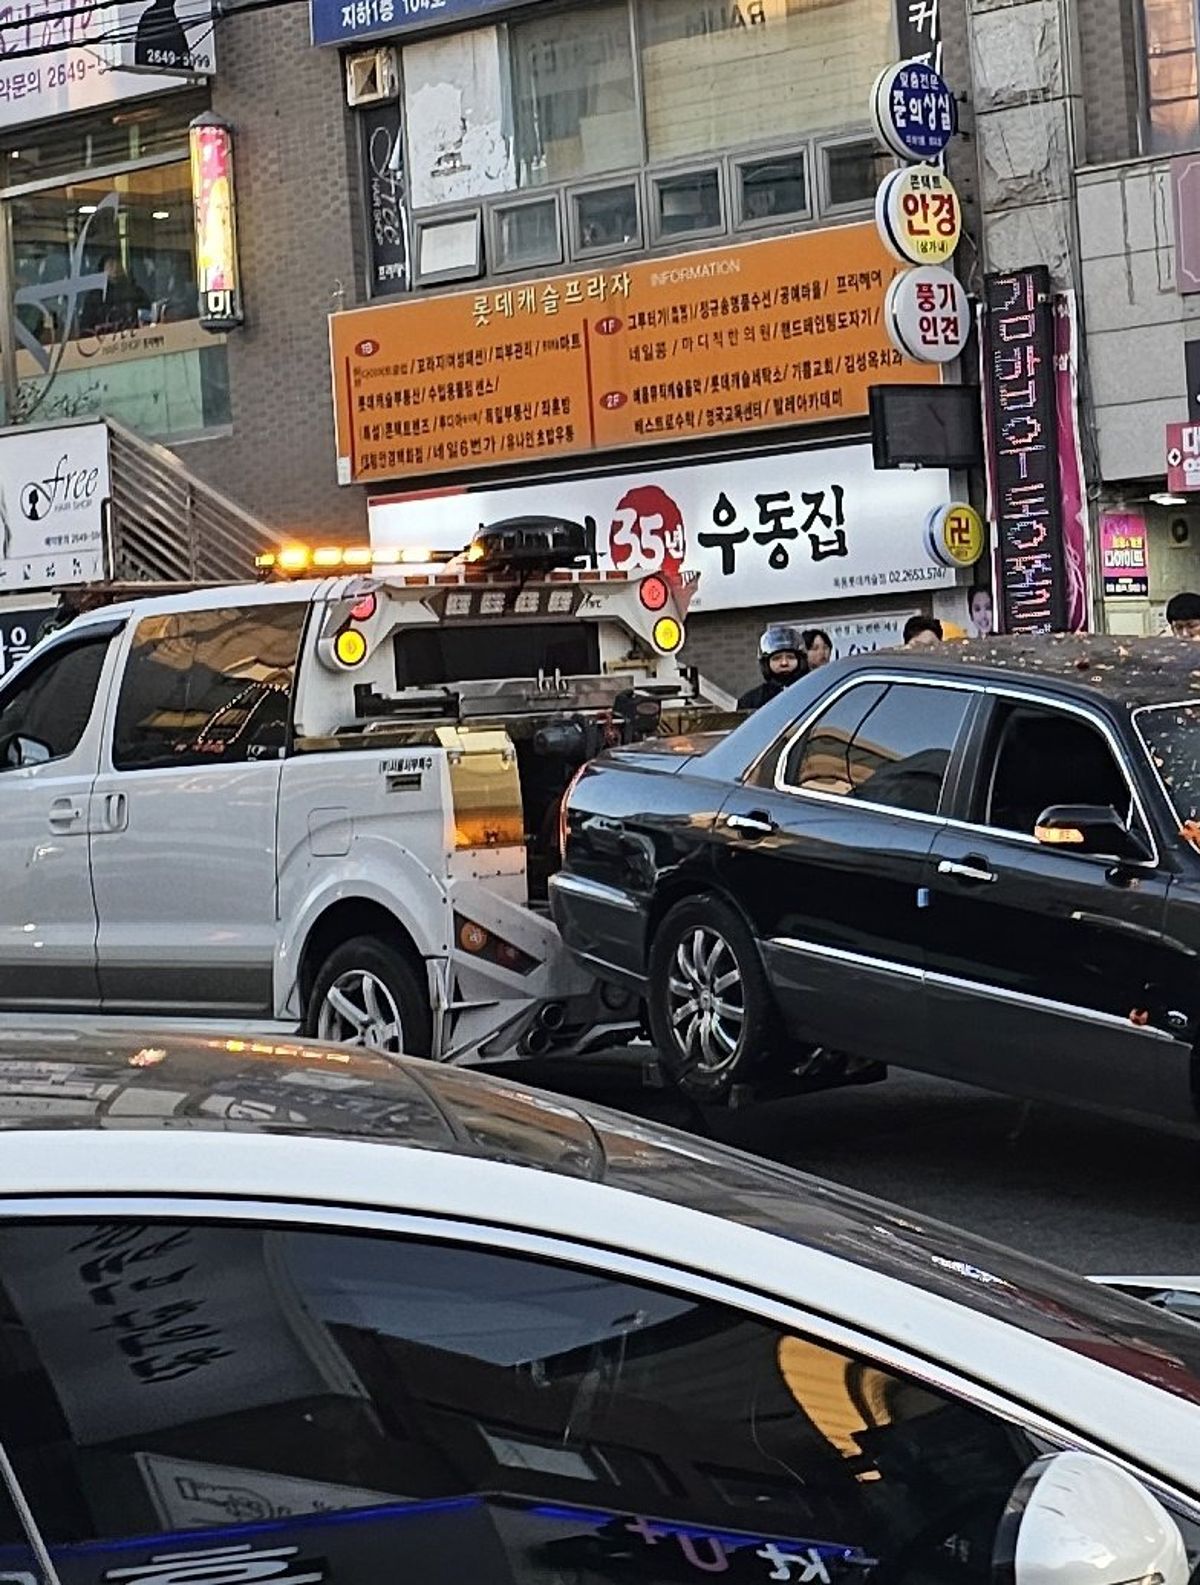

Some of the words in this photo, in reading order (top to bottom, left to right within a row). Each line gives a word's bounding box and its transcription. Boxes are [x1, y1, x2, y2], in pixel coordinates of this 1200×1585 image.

[902, 193, 956, 236] 안경
[471, 271, 632, 326] 롯데캐슬프라자
[651, 259, 741, 287] INFORMATION
[915, 284, 957, 312] 풍기
[919, 315, 960, 346] 인견
[42, 454, 99, 501] free
[698, 483, 848, 576] 우동집
